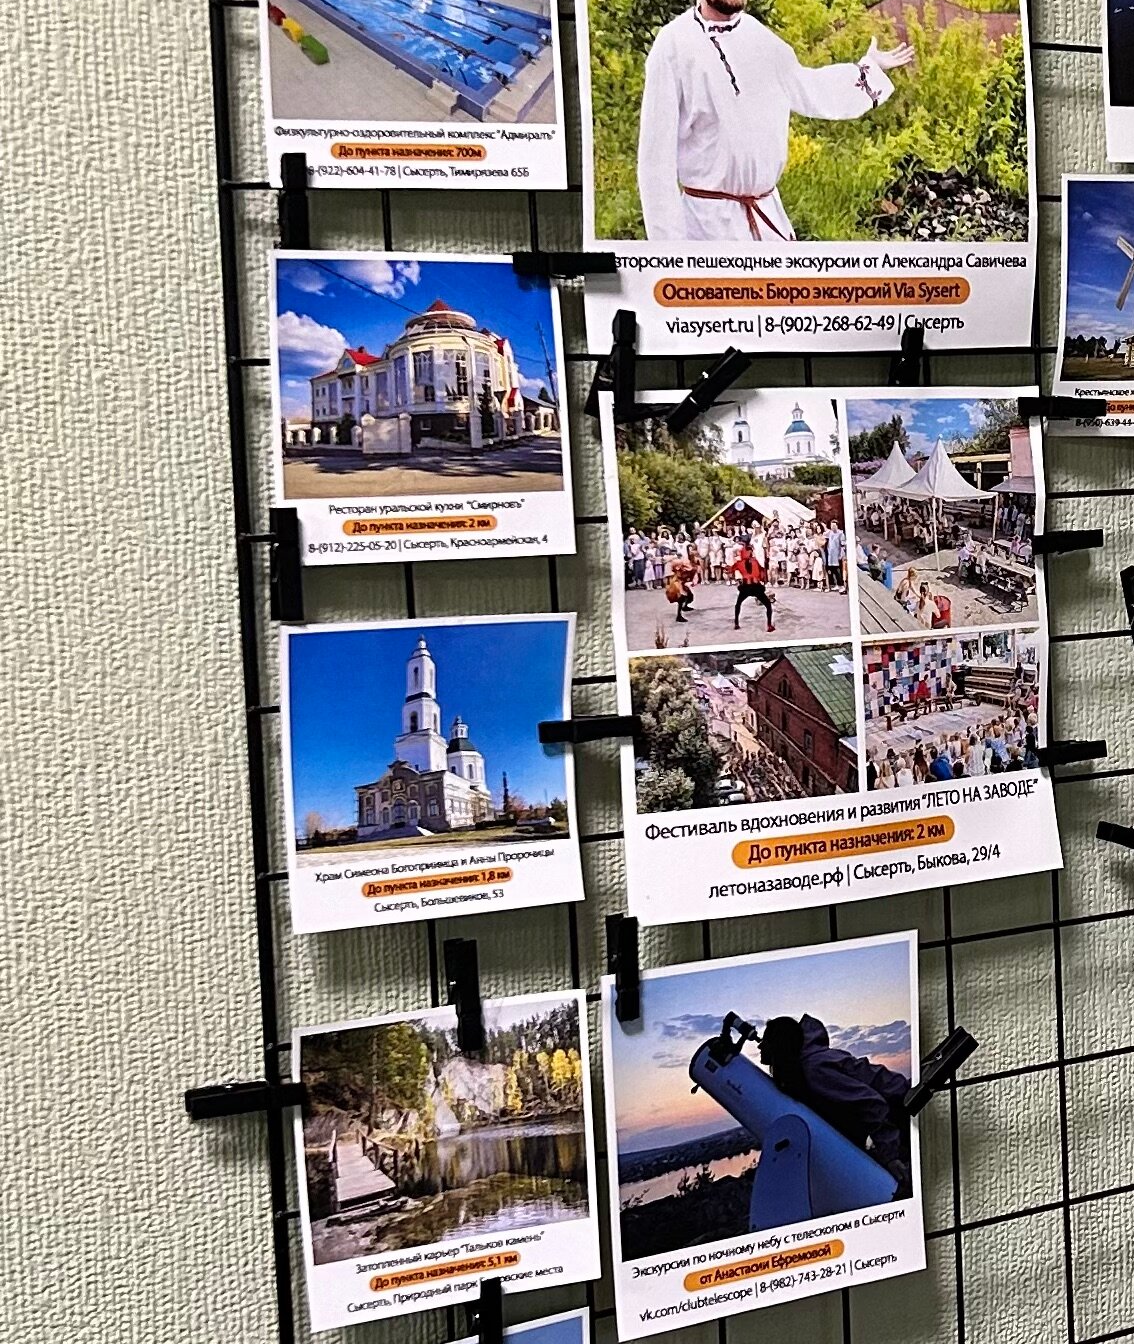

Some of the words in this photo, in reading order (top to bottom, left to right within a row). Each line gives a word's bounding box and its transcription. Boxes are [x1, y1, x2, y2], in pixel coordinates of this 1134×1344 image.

[339, 146, 353, 157] До
[456, 146, 482, 158] 700м
[688, 256, 781, 271] пешеходные
[786, 255, 859, 272] экскурсии
[864, 257, 879, 268] от
[882, 253, 962, 270] Александра
[966, 254, 1026, 268] Савичева
[663, 283, 763, 300] Основатель:
[767, 283, 810, 303] Бюро
[813, 283, 891, 302] экскурсий
[894, 283, 915, 298] Via
[919, 282, 960, 302] Sysert
[666, 318, 753, 336] viasysert.ru
[765, 315, 894, 334] 8-(902)-268-62-49
[905, 315, 964, 332] Сысерть
[645, 819, 737, 841] Фестиваль
[741, 808, 844, 833] вдохновения
[848, 807, 857, 818] и
[861, 798, 920, 823] развития
[963, 786, 981, 803] НА
[748, 845, 771, 865] До
[775, 839, 827, 861] пункта
[830, 828, 915, 853] назначения:
[917, 824, 925, 839] 2
[928, 823, 946, 838] км
[709, 867, 844, 899] летоназаводе.рф
[854, 858, 915, 882] Сысерть,
[918, 849, 971, 871] Быкова,
[972, 844, 1001, 863] 29/4
[632, 1258, 690, 1279] Экскурсии
[692, 1253, 706, 1264] по
[708, 1241, 755, 1262] ночному
[758, 1234, 782, 1250] небу
[784, 1235, 790, 1244] с
[854, 1219, 860, 1228] в
[862, 1208, 905, 1227] Сысерти
[700, 1274, 713, 1285] от
[714, 1261, 769, 1282] Анастасии
[854, 1253, 897, 1271] Сысерть
